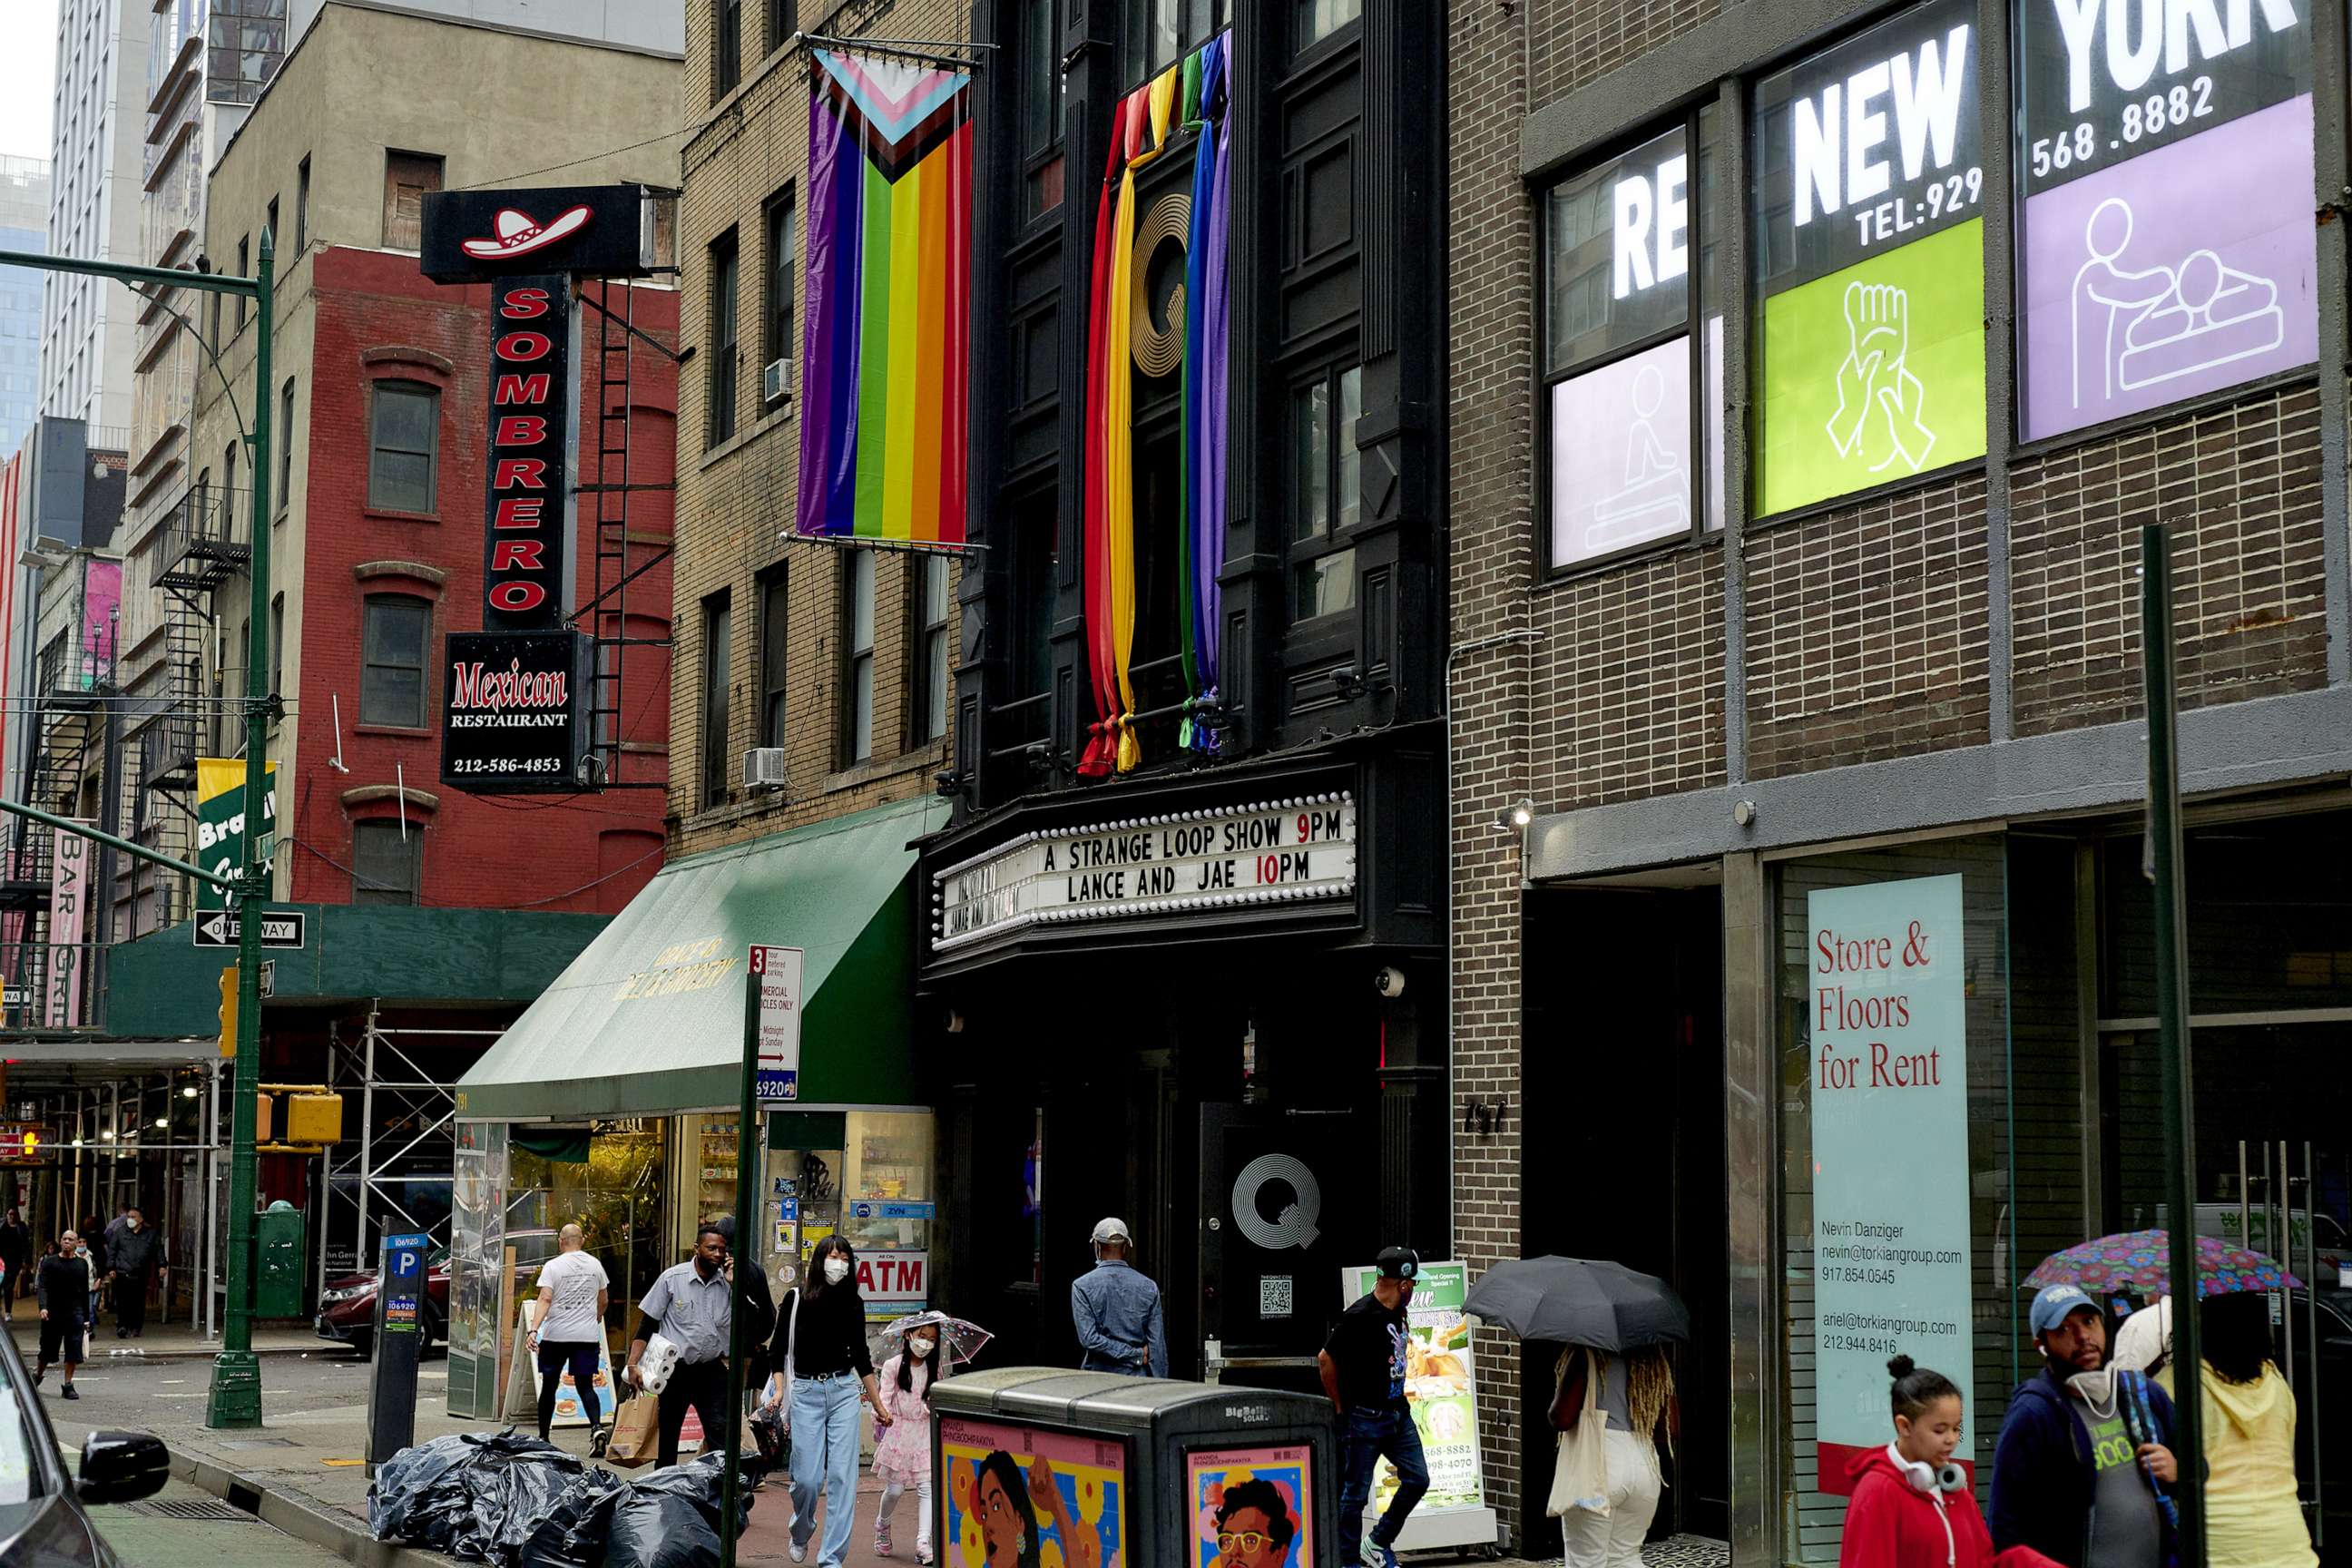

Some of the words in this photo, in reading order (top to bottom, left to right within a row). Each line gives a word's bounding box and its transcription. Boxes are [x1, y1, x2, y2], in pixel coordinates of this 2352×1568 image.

[1794, 23, 1970, 228] NEW
[2032, 122, 2093, 178] 568
[1856, 167, 1984, 246] TEL:929
[1613, 153, 1688, 300] RE
[489, 288, 552, 611] SOMBRERO
[451, 657, 569, 714] Mexican
[450, 713, 568, 728] RESTAURANT
[454, 757, 561, 773] 212-586-4853
[198, 790, 276, 851] Brail
[1044, 845, 1055, 871] A
[1069, 833, 1152, 869] STRANGE
[1163, 825, 1215, 858] LOOP
[1223, 818, 1282, 852] SHOW
[1297, 809, 1341, 843] 9PM
[58, 835, 83, 915] BAR
[1068, 871, 1125, 902] LANCE
[1137, 866, 1175, 897] AND
[1197, 859, 1235, 890] JAE
[1256, 850, 1309, 886] 10PM
[212, 922, 241, 936] ONE
[260, 923, 289, 936] WAY
[1816, 928, 1892, 974] Store
[1902, 919, 1931, 967] &
[753, 948, 762, 973] 3
[768, 960, 786, 969] metered
[767, 968, 784, 979] parking
[53, 946, 76, 1026] GRIL
[760, 985, 788, 997] MERCIAL
[760, 999, 777, 1010] ICLES
[778, 1000, 794, 1011] ONLY
[1817, 985, 1910, 1031] Floors
[763, 1025, 784, 1037] Midnight
[765, 1037, 783, 1048] Sunday
[1818, 1044, 1859, 1089] for
[1868, 1043, 1941, 1088] Rent
[756, 1081, 784, 1096] 6920
[457, 1093, 467, 1111] 791
[887, 1207, 905, 1215] ZYN
[1231, 1153, 1320, 1250] Q
[1822, 1220, 1852, 1236] Nevin
[1855, 1222, 1904, 1241] Danziger
[394, 1238, 419, 1247] 106920
[399, 1252, 416, 1275] P
[1822, 1244, 1962, 1266] nevin@torkiangroup.com
[856, 1260, 922, 1292] ATM
[1822, 1267, 1896, 1284] 917.854.0545
[388, 1302, 416, 1310] 106920
[1407, 1290, 1436, 1308] ew
[1823, 1312, 1956, 1336] ariel@torkiangroup.com
[1824, 1335, 1896, 1354] 212.944.8416
[942, 1421, 964, 1432] AMANDA
[1242, 1415, 1264, 1423] SOLAR
